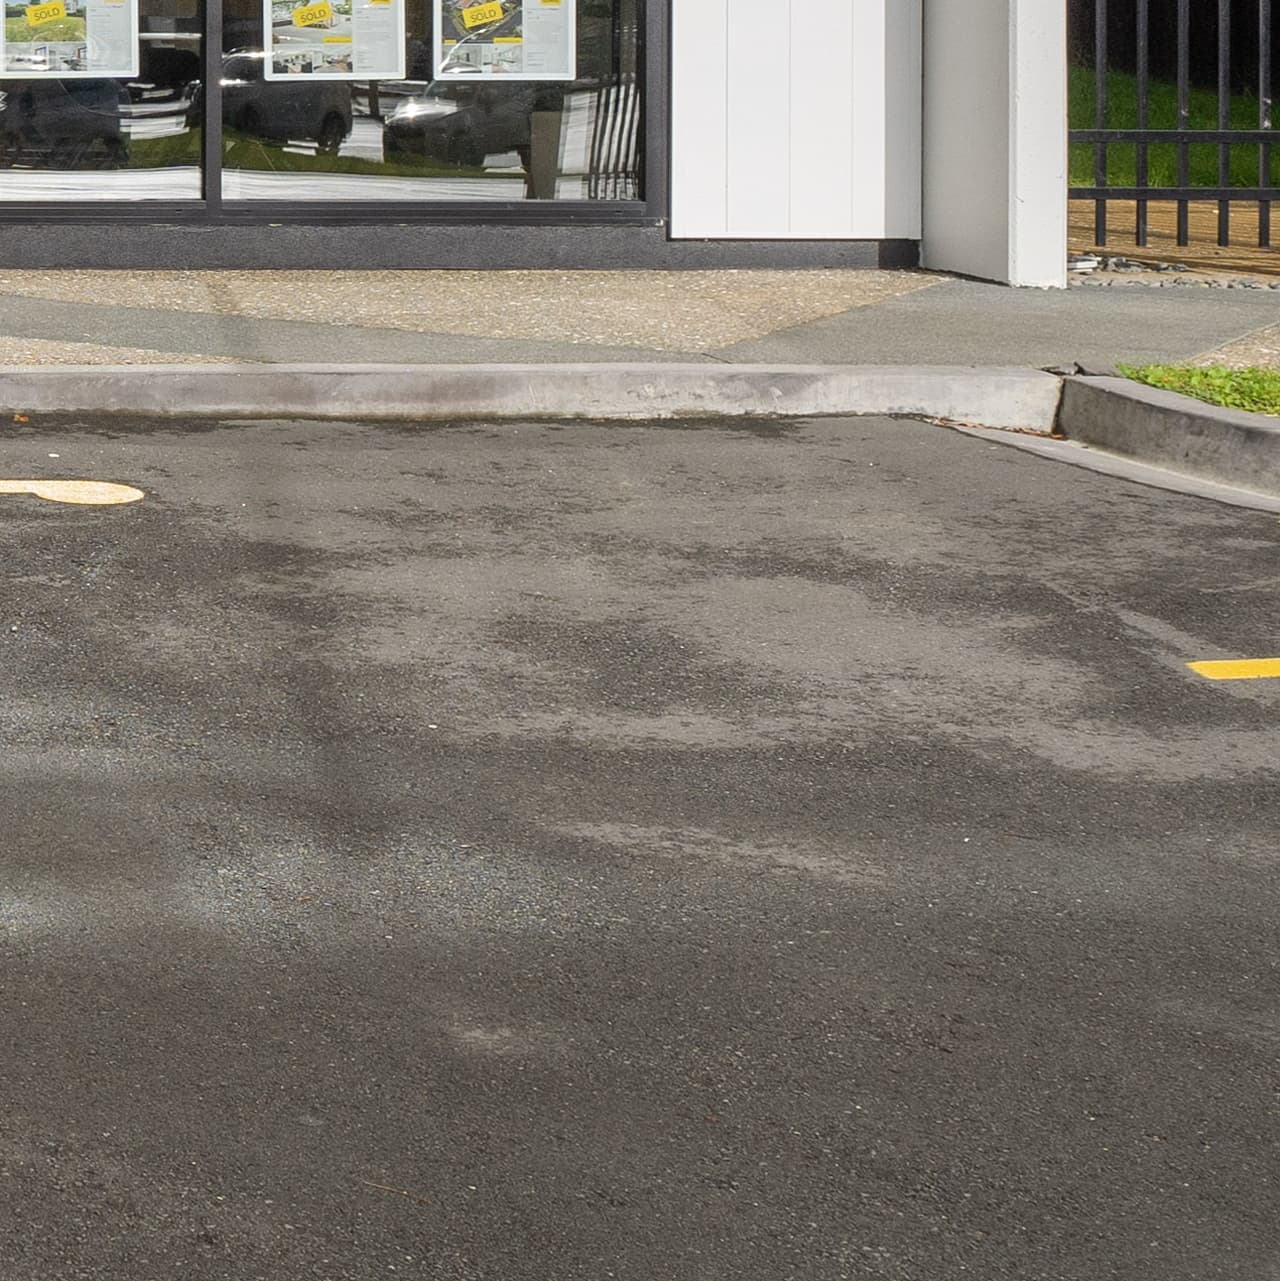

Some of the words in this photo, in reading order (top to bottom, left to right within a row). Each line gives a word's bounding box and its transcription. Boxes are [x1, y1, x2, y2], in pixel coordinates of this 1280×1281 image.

[34, 7, 60, 21] SOLD
[300, 9, 326, 22] SOLD
[470, 9, 496, 22] SOLD
